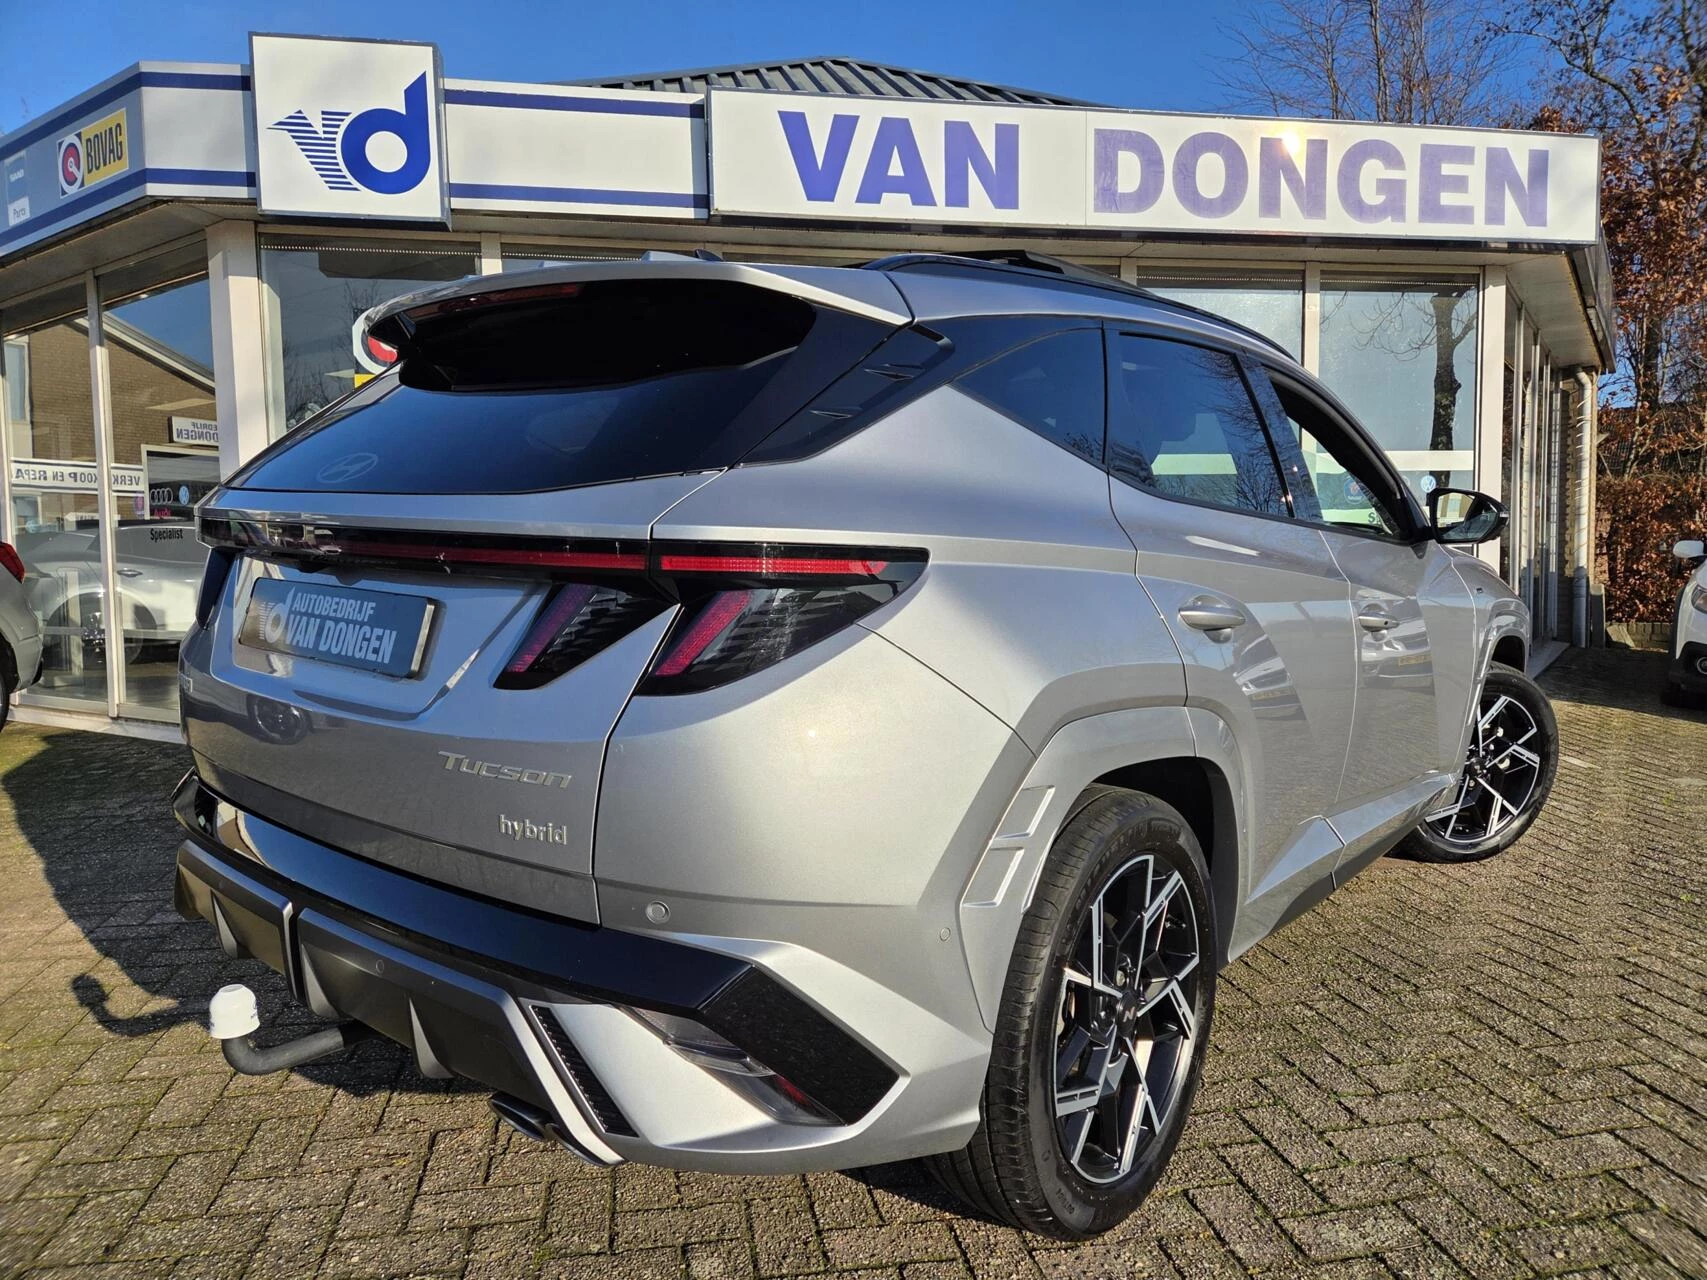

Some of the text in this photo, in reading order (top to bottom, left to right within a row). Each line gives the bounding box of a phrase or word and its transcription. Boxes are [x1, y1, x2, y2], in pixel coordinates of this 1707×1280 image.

[85, 122, 124, 174] BOVAG
[777, 110, 1550, 227] VAN DONGEN
[150, 528, 183, 543] Specialist
[292, 592, 376, 622] AUTOBEDRIJF
[285, 614, 398, 664] VAN DONGEN
[499, 813, 567, 846] hybrid
